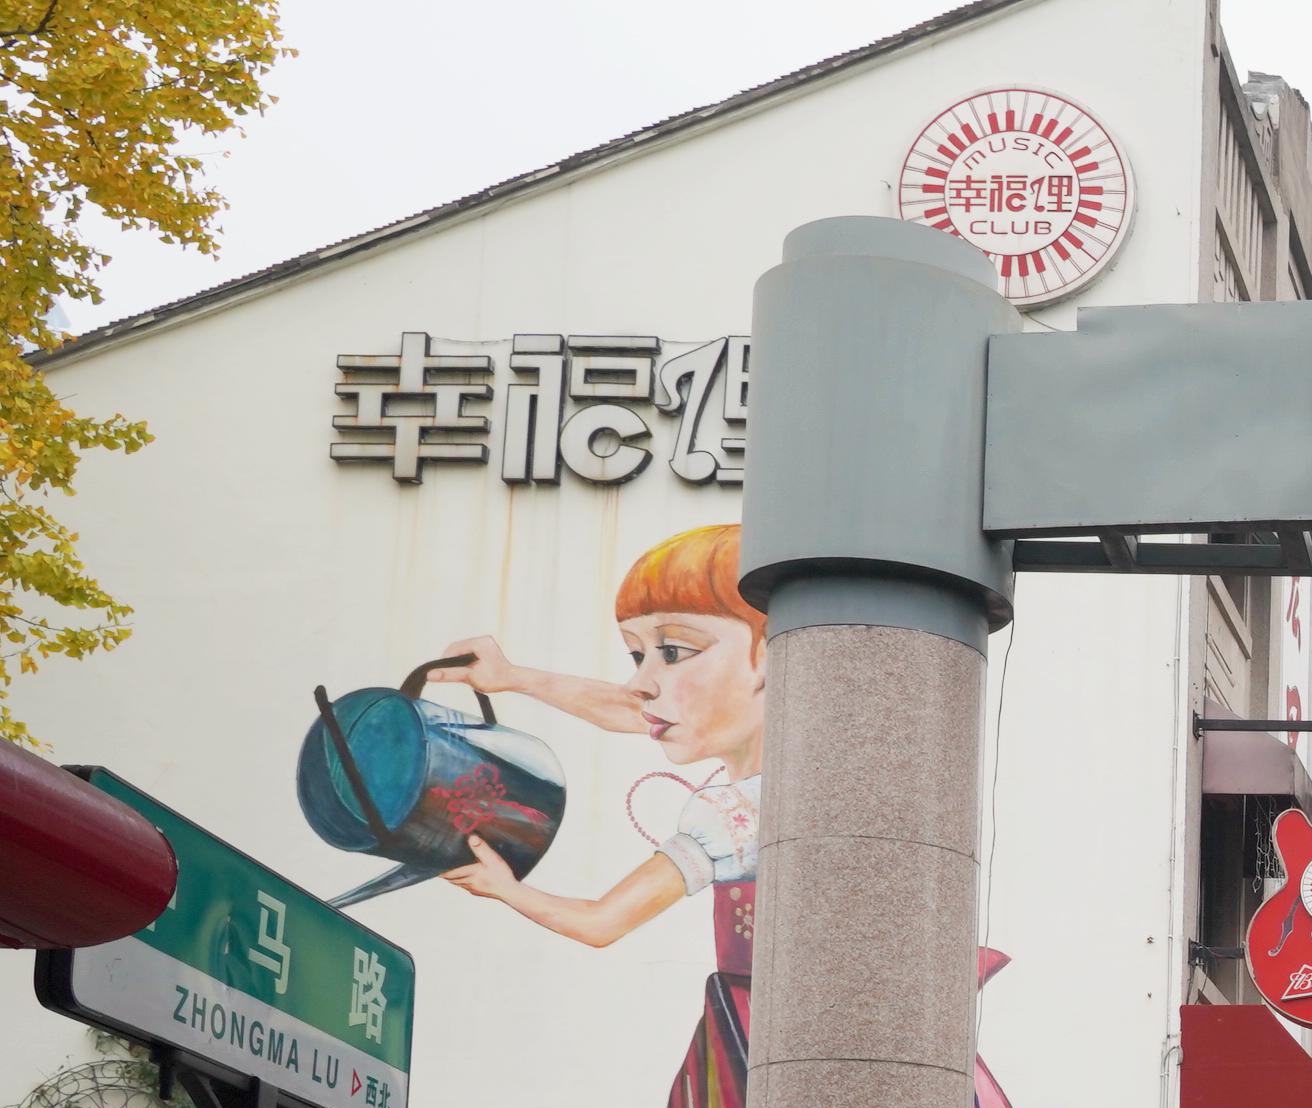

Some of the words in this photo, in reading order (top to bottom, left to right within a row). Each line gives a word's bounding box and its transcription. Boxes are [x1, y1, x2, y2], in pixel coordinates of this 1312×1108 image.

[963, 137, 1063, 170] MUSIC
[970, 220, 1052, 235] CLUB
[148, 888, 387, 1044] 马路
[173, 985, 299, 1074] ZHONGMA
[312, 1049, 340, 1089] LU
